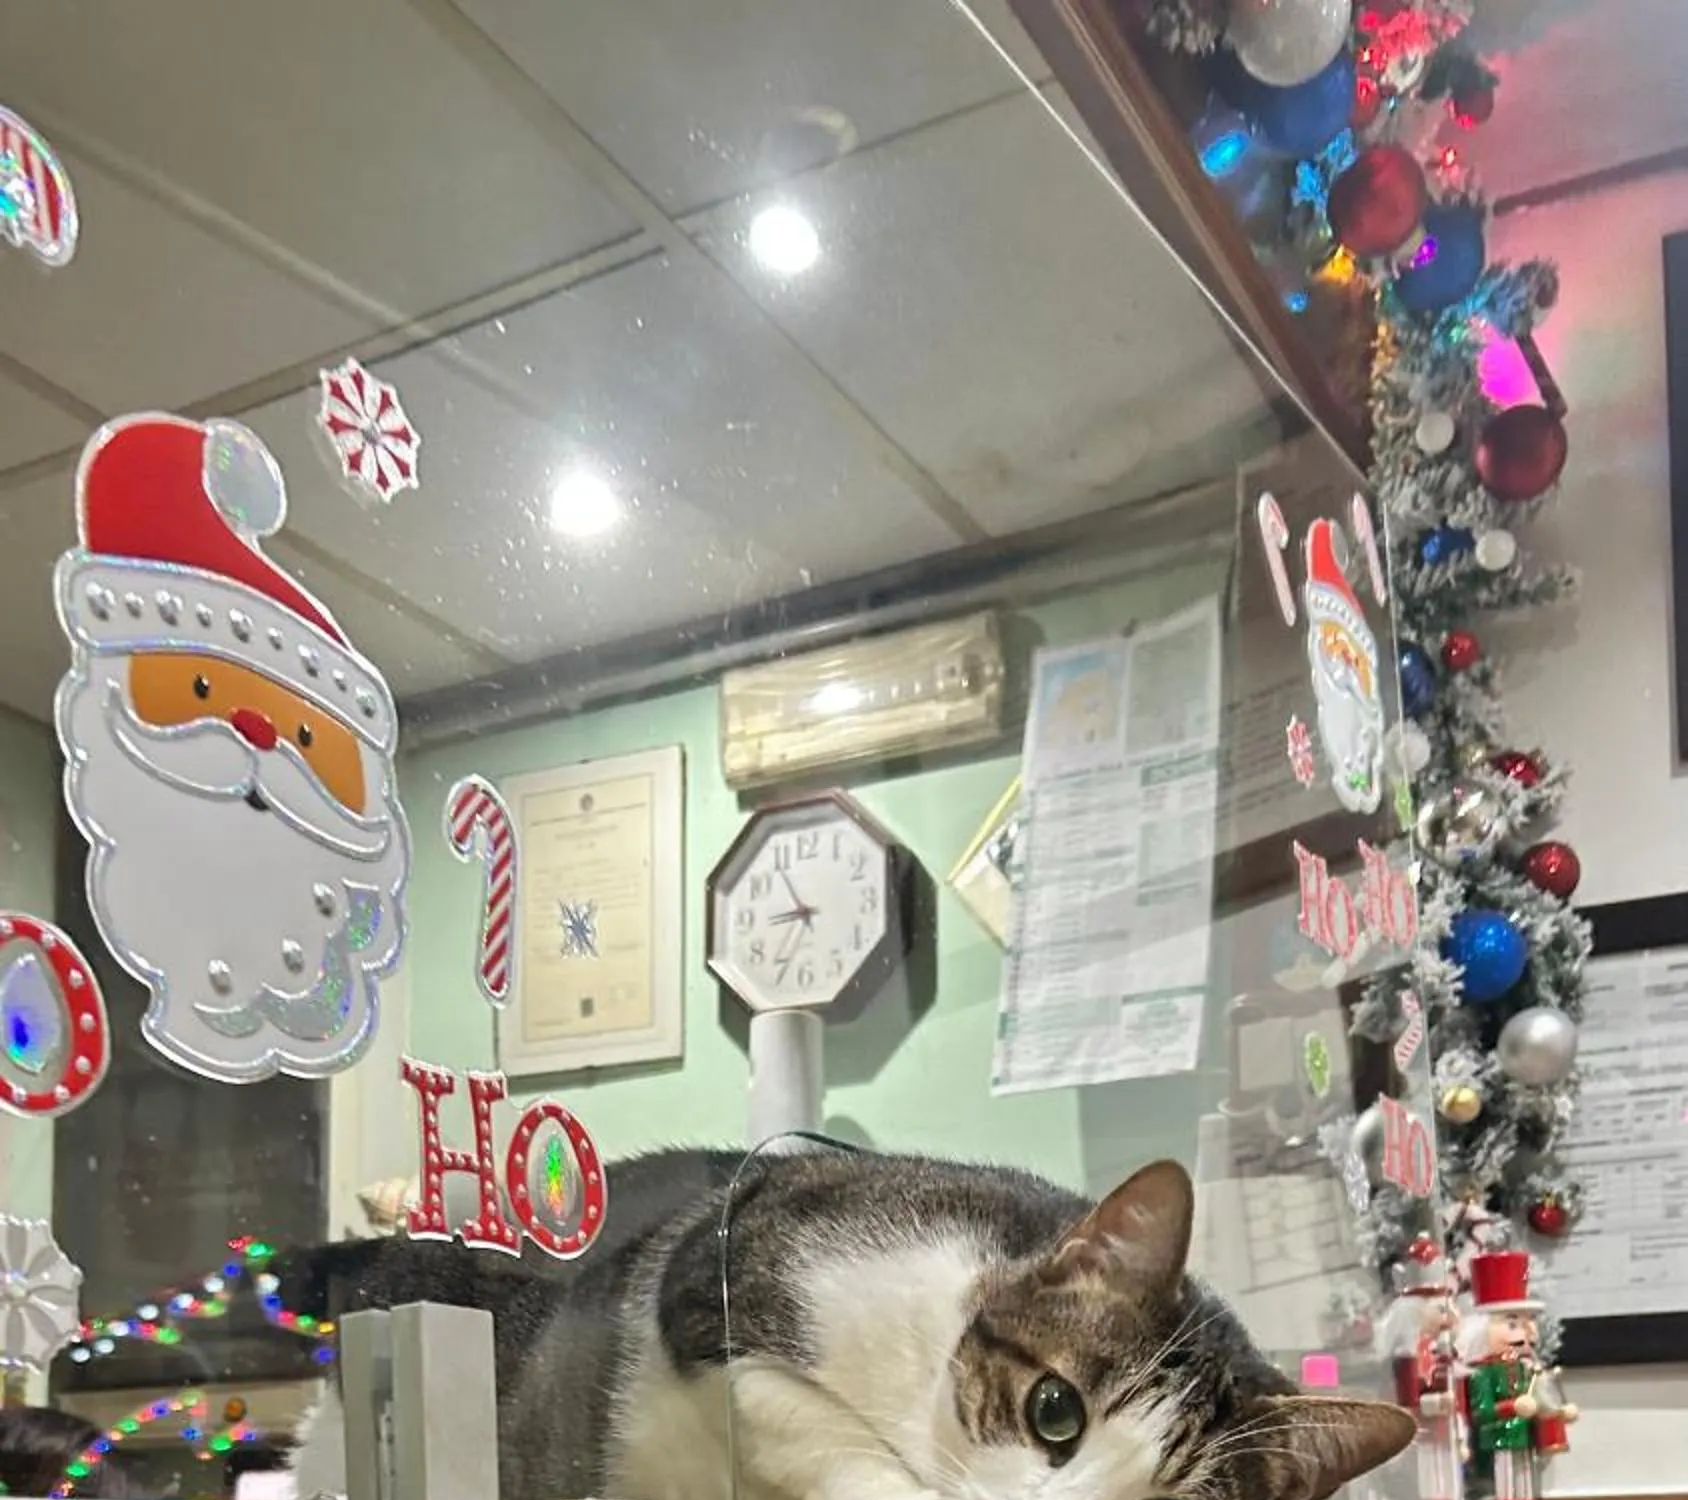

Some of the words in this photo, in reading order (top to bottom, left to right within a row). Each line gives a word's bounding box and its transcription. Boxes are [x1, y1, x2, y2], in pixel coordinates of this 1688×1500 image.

[774, 843, 792, 871] 11
[797, 831, 819, 861] 12
[849, 851, 867, 881] 2
[750, 871, 773, 900] 10
[860, 886, 877, 914] 3
[1293, 839, 1357, 961] HO
[1358, 837, 1417, 947] HO
[735, 909, 755, 934] 9
[749, 938, 765, 964] 8
[826, 949, 843, 977] 5
[774, 956, 790, 986] 7
[797, 961, 814, 987] 6
[400, 1056, 608, 1260] HO
[1379, 1091, 1435, 1198] HO
